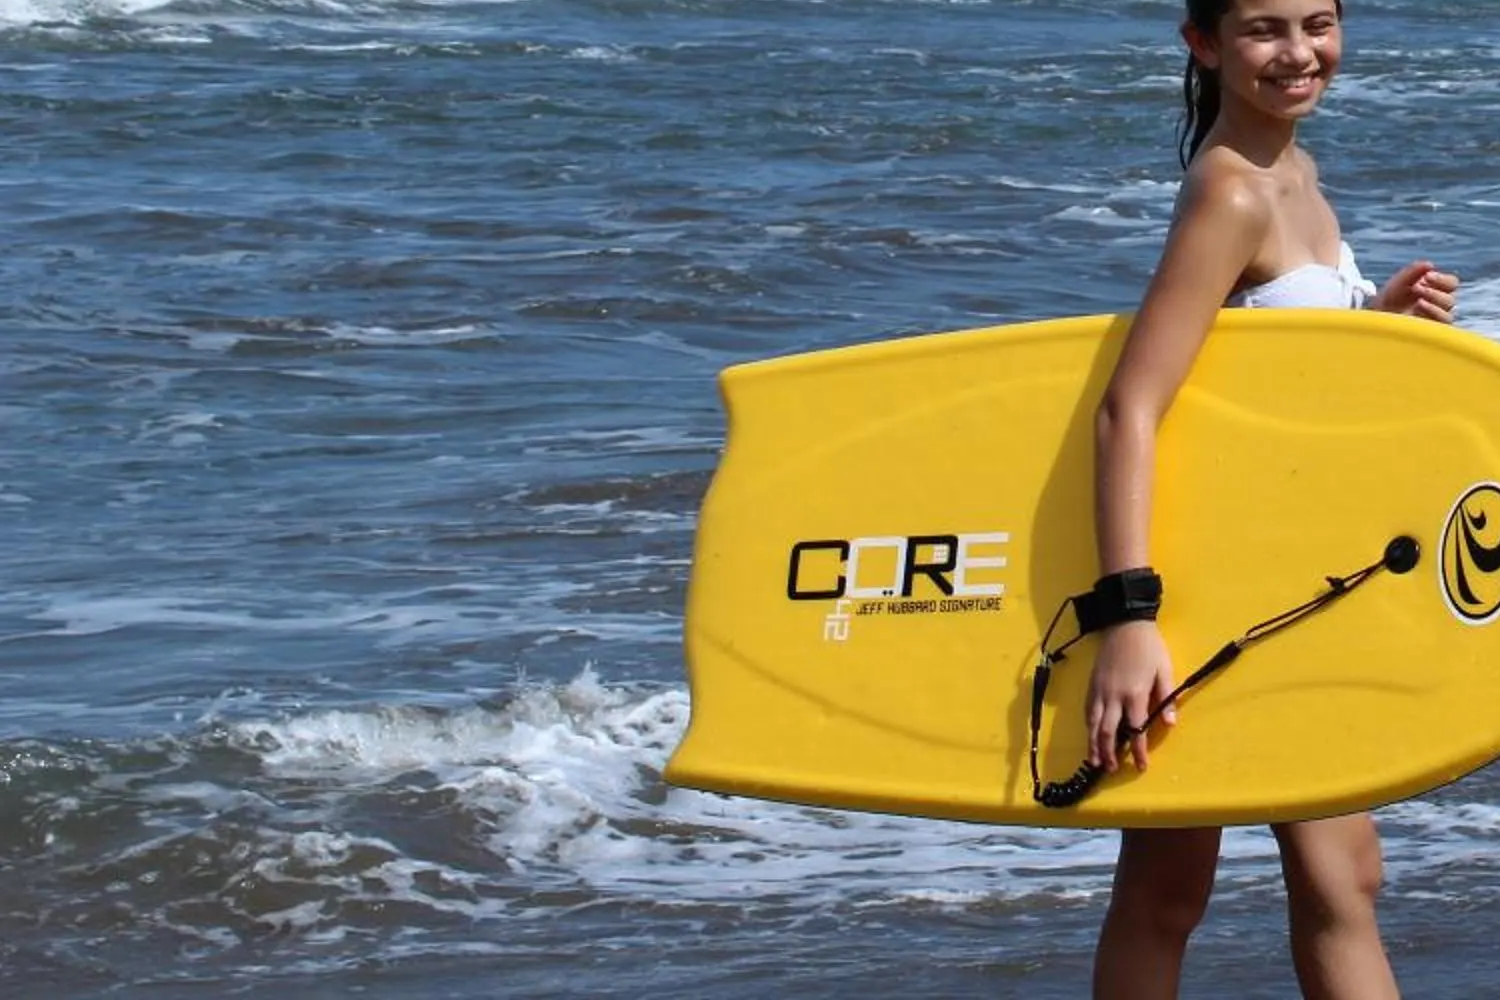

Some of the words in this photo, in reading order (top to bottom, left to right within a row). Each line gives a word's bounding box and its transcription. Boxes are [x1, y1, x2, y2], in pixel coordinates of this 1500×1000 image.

[787, 531, 1011, 600] CORE
[856, 601, 884, 616] JEFF
[887, 600, 937, 615] HUBBARD
[939, 597, 1002, 613] SIGNATURE
